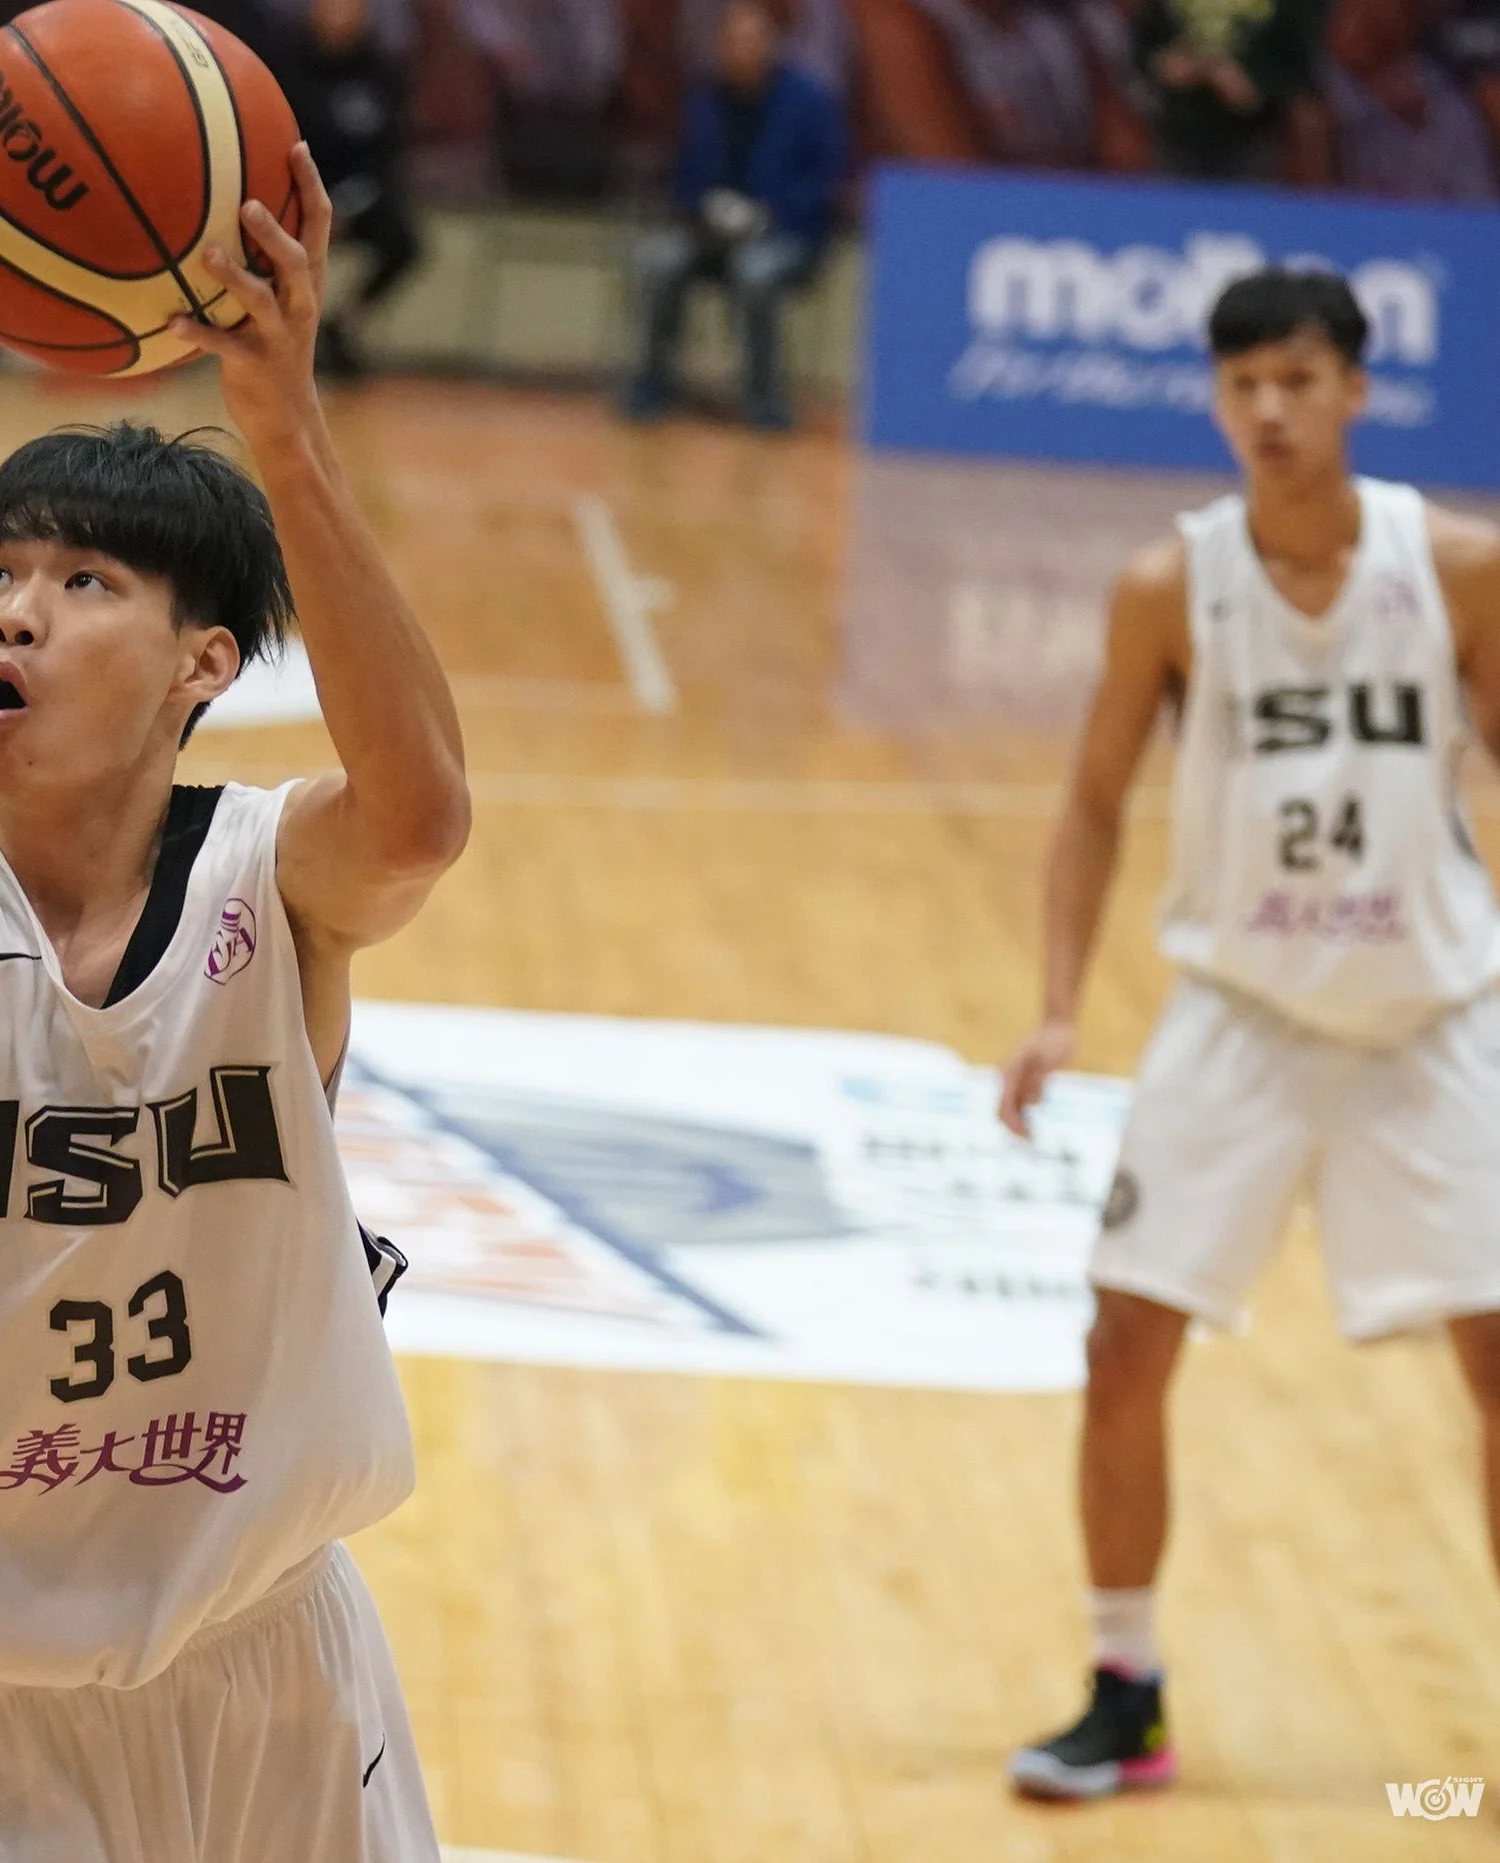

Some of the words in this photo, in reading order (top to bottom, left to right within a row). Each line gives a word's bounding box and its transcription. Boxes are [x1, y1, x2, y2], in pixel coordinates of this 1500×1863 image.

[968, 236, 1438, 366] moln
[1248, 679, 1428, 755] SU
[1277, 793, 1366, 874] 24
[49, 1269, 192, 1404] 33
